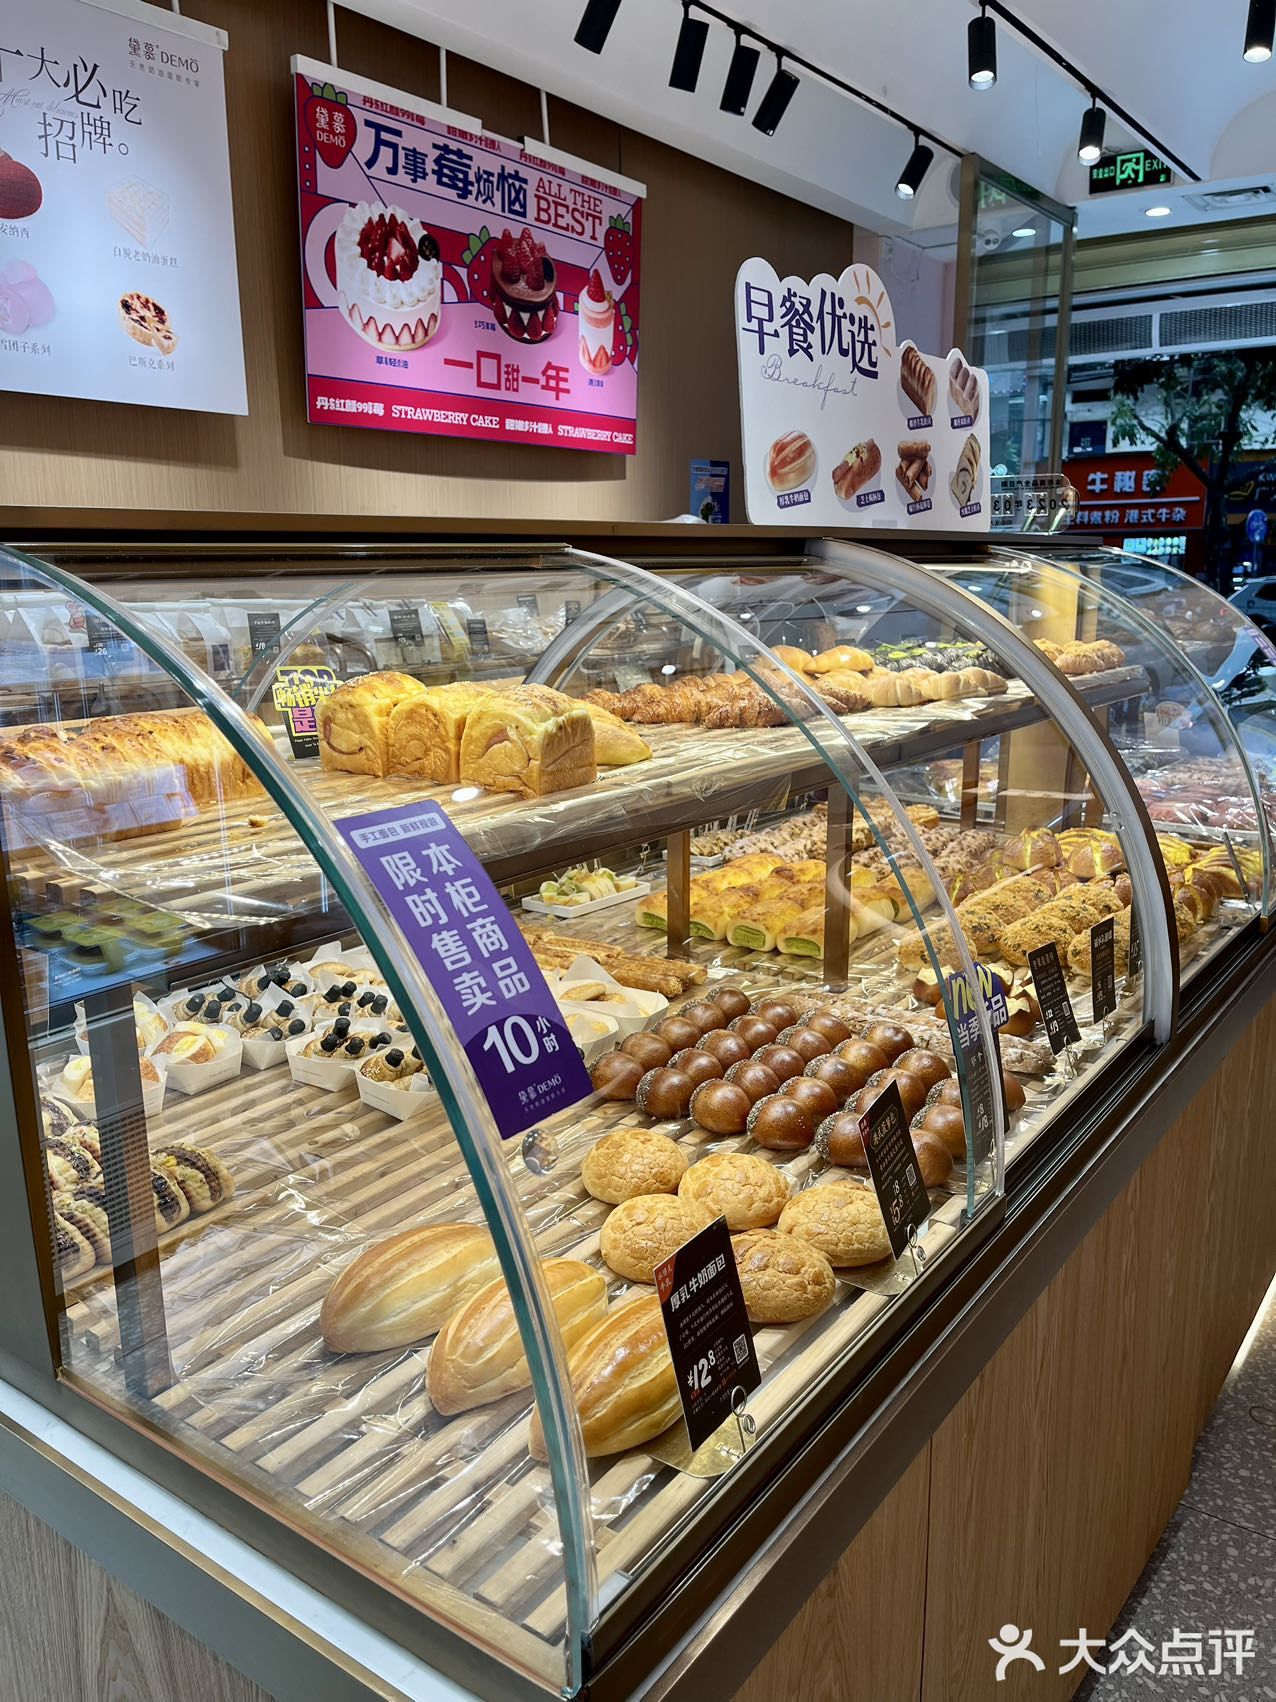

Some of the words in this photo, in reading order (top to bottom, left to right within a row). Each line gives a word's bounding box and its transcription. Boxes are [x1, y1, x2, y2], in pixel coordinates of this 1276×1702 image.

[363, 118, 529, 220] 万事莓烦恼
[535, 176, 567, 201] ALL
[570, 188, 603, 215] THE
[534, 193, 603, 242] BEST
[742, 281, 879, 380] 早餐优选
[443, 350, 571, 401] 一口甜一年
[761, 354, 858, 411] Breakfast
[392, 404, 468, 427] STRAWBERRY
[470, 414, 500, 429] CAKE
[558, 425, 612, 442] STRAWBERRY
[612, 432, 634, 445] CAKE
[359, 826, 400, 844] 手工面包
[380, 850, 497, 1017] 限时售卖
[422, 842, 531, 1000] 本柜商品
[482, 1014, 541, 1074] 10
[535, 1014, 560, 1054] 小时
[957, 993, 1008, 1049] 当季品
[670, 1253, 727, 1312] 厚乳牛奶面包
[687, 1349, 716, 1390] ¥12.8
